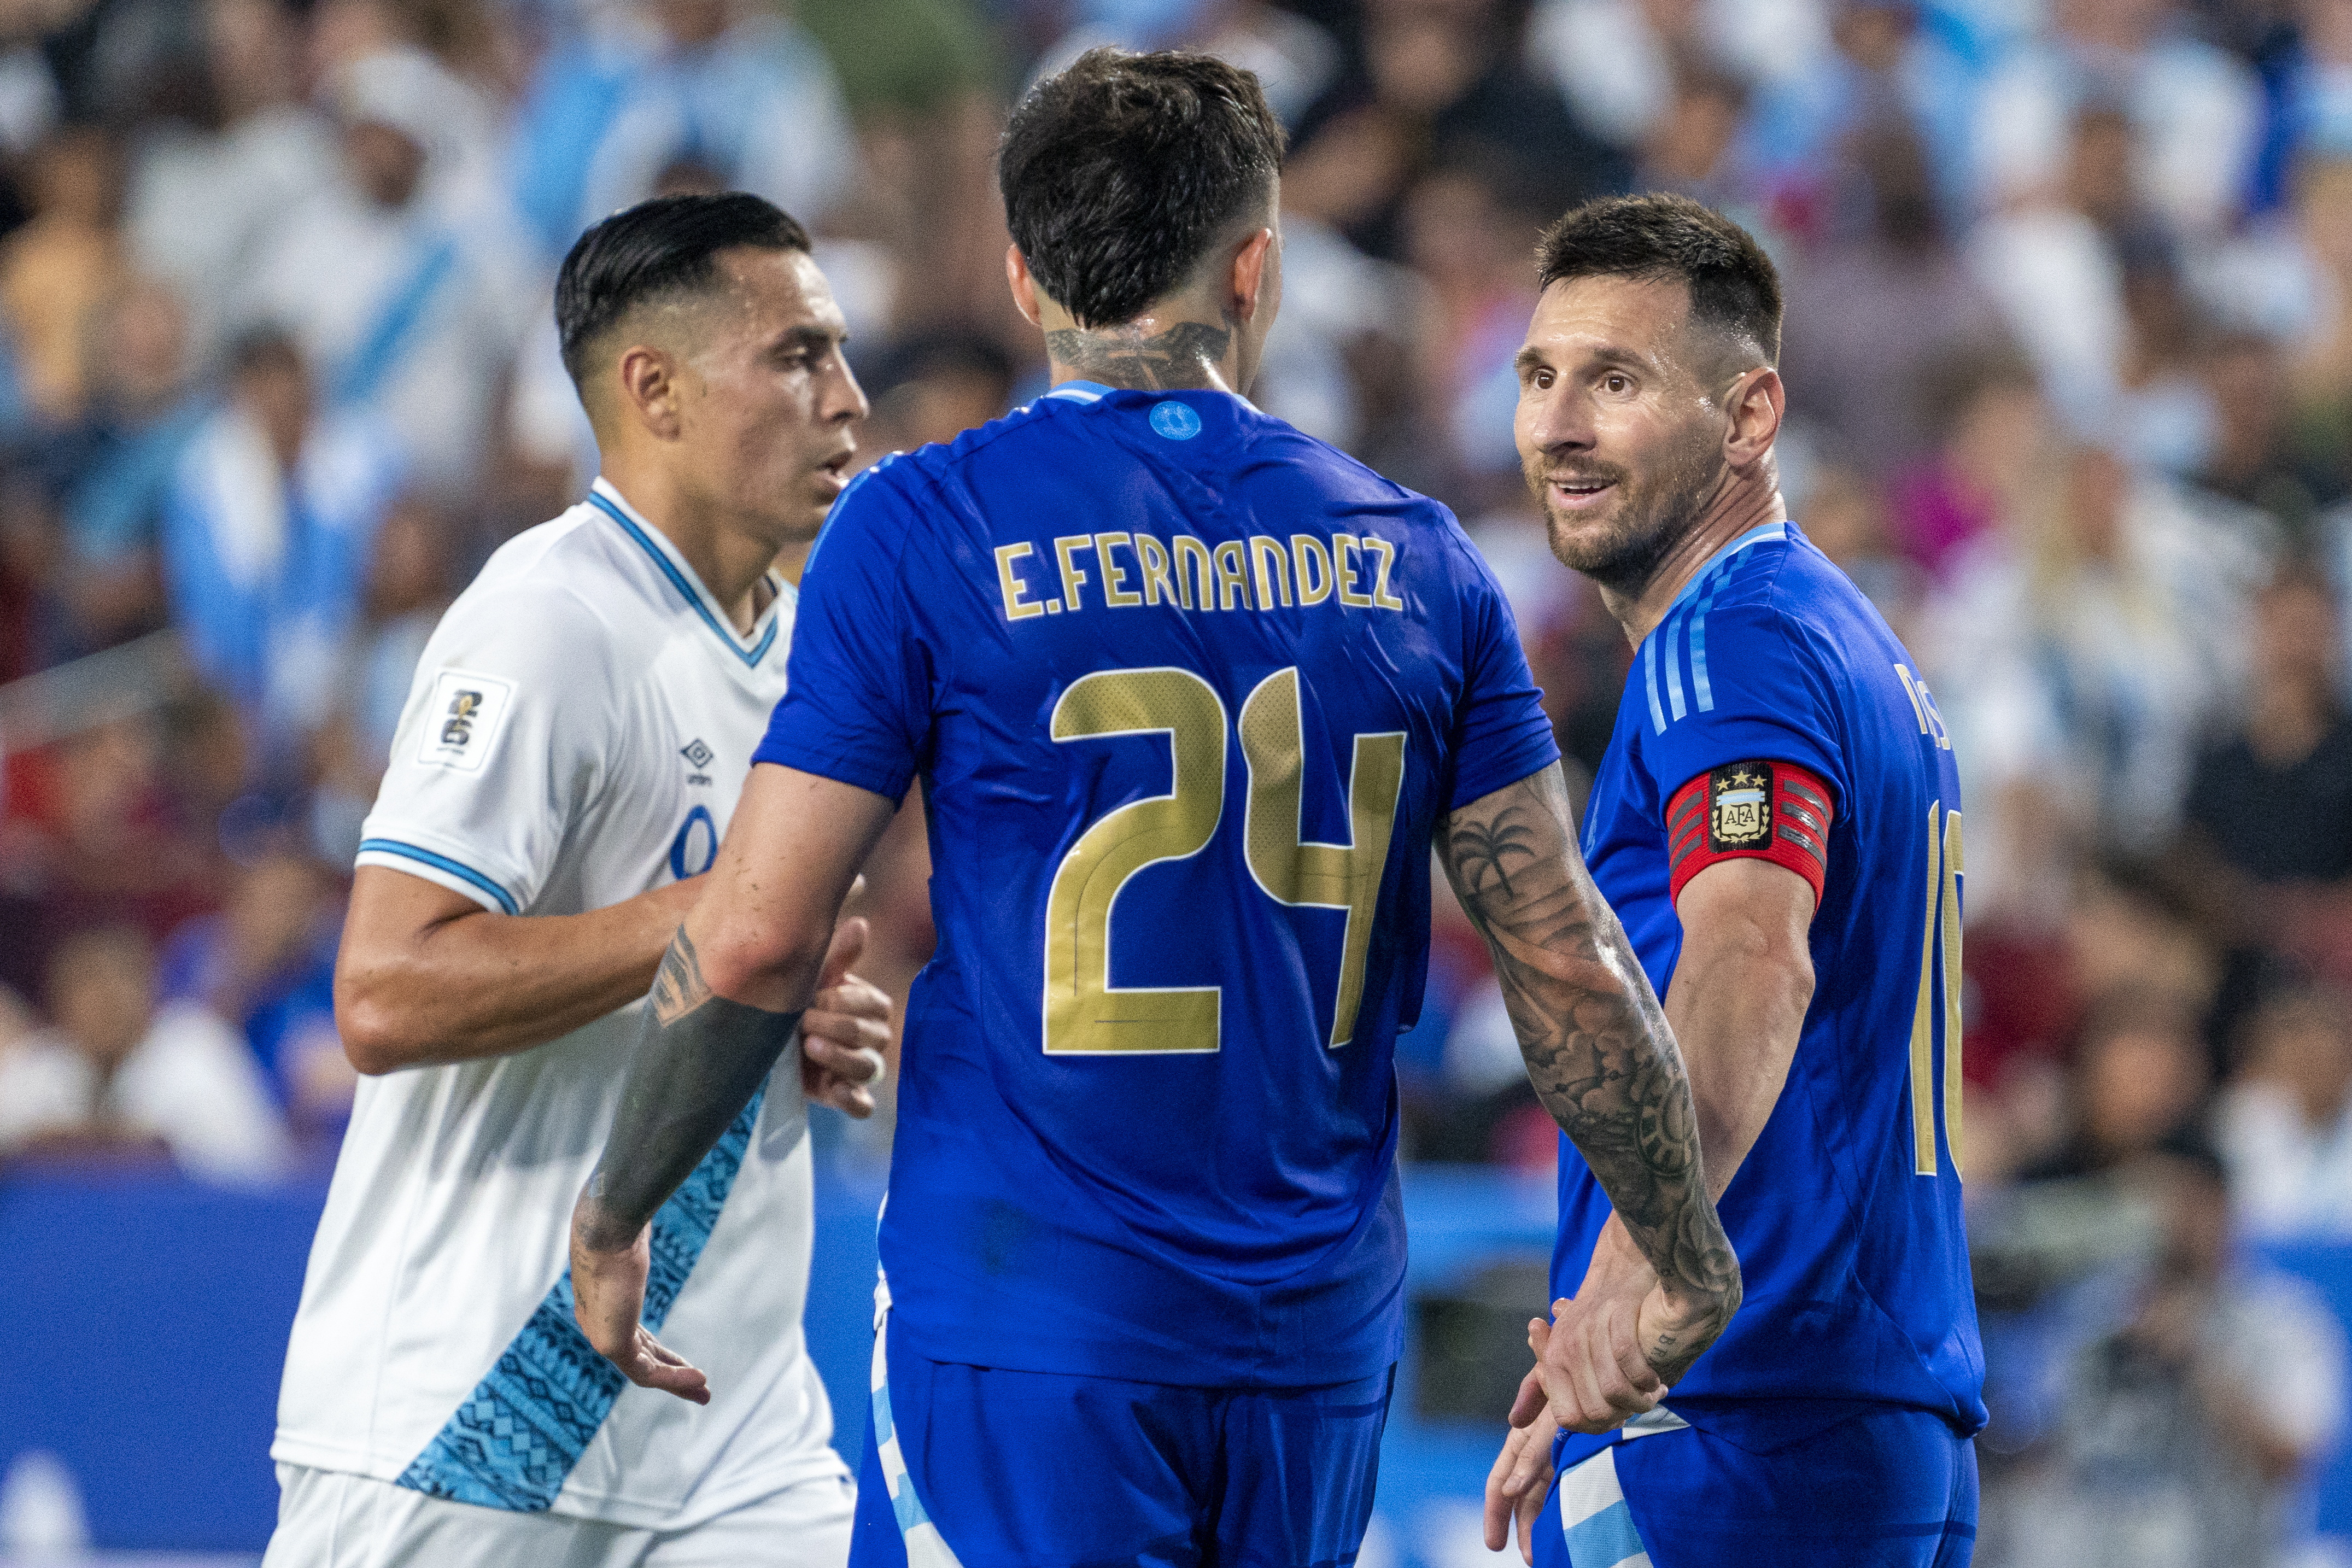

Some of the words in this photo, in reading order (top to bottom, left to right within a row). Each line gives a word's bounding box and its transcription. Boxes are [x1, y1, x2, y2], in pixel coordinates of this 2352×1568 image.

[994, 531, 1403, 621] E.FERNANDEZ
[1724, 802, 1756, 827] AFA
[1043, 665, 1407, 1055] 24
